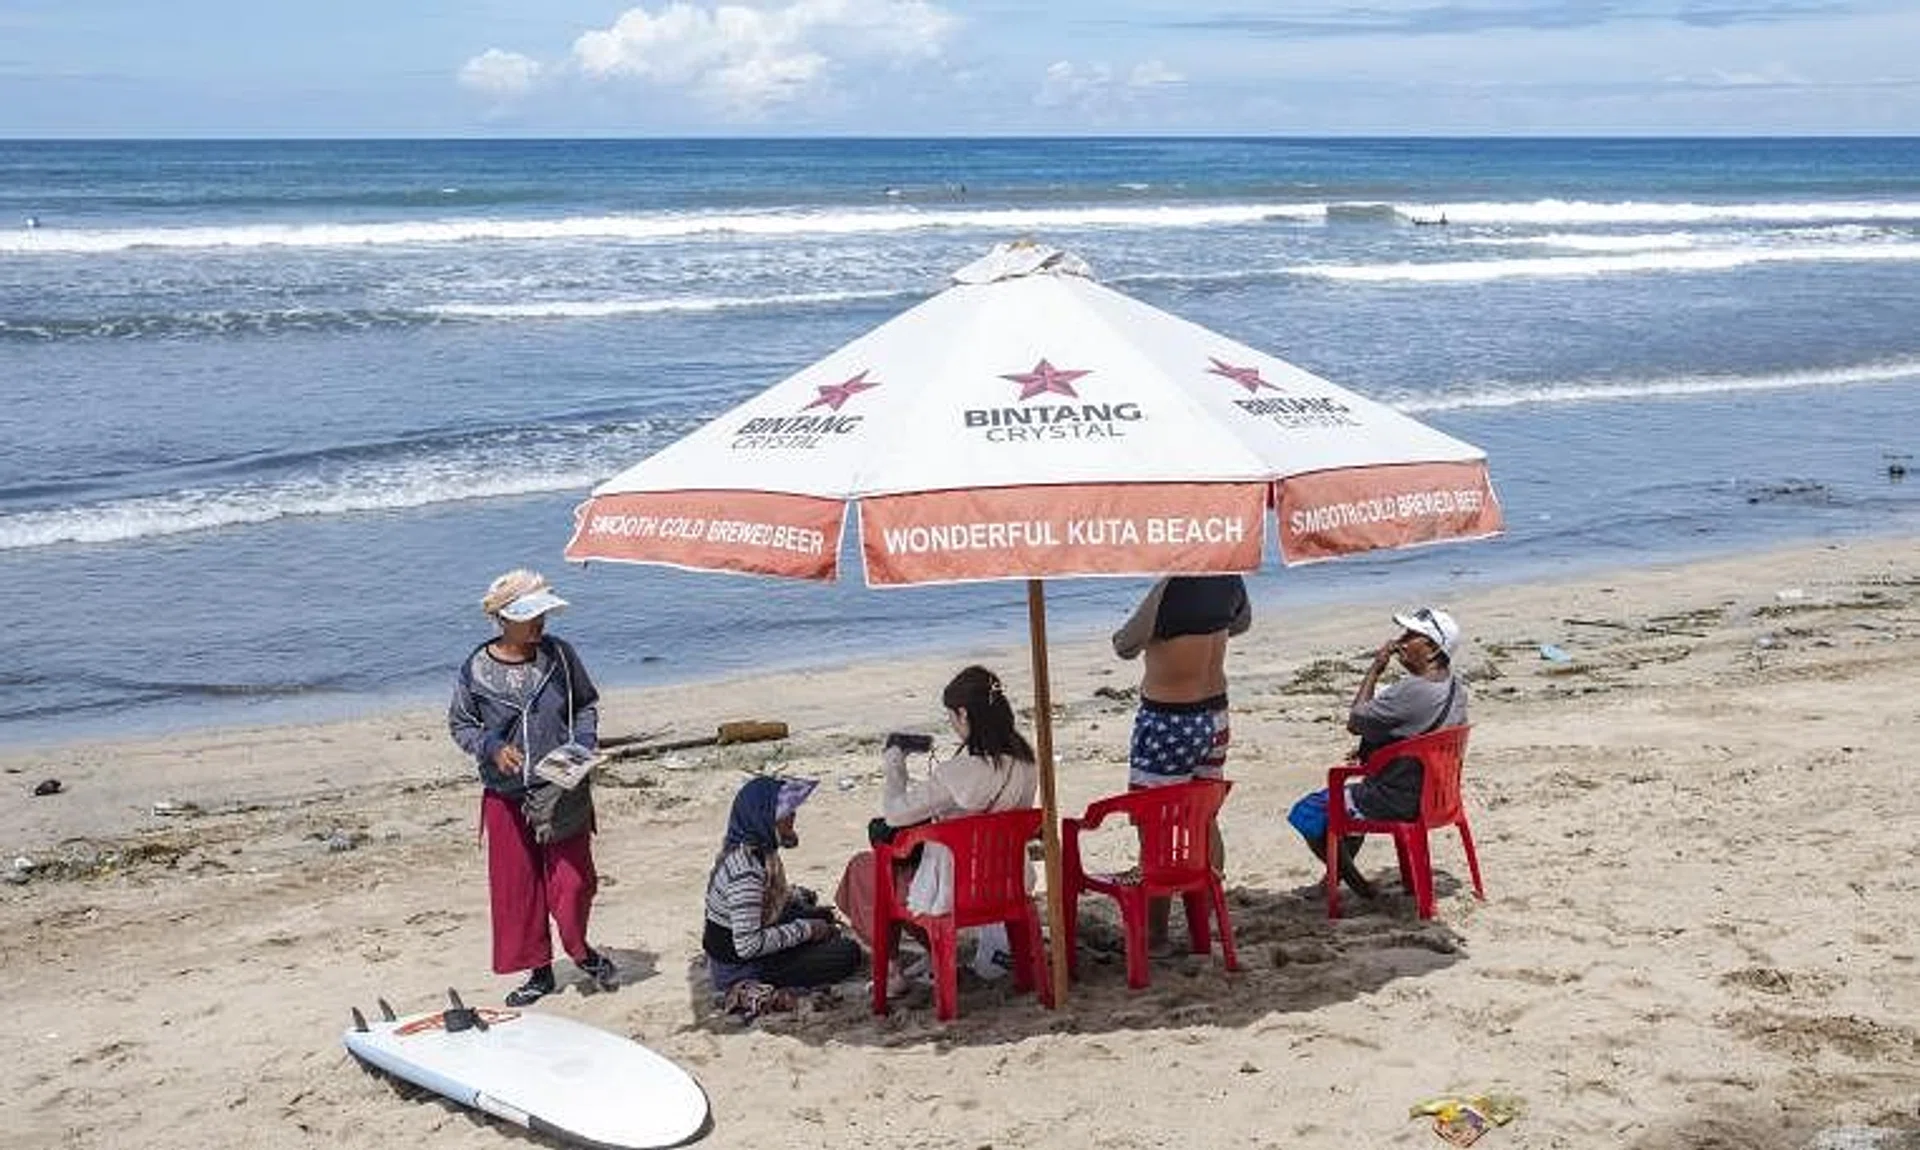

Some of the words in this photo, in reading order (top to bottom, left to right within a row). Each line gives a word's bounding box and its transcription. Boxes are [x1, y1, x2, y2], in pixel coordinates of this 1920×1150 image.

[737, 416, 863, 434] BINTANG
[965, 403, 1142, 427] BINTANG
[985, 423, 1126, 442] CRYSTAL
[659, 517, 703, 538] COLD
[707, 520, 774, 545] BREWED
[772, 525, 824, 555] BEER
[883, 521, 1061, 555] WONDERFUL
[1067, 518, 1140, 545] KUTA
[1146, 517, 1244, 543] BEACH
